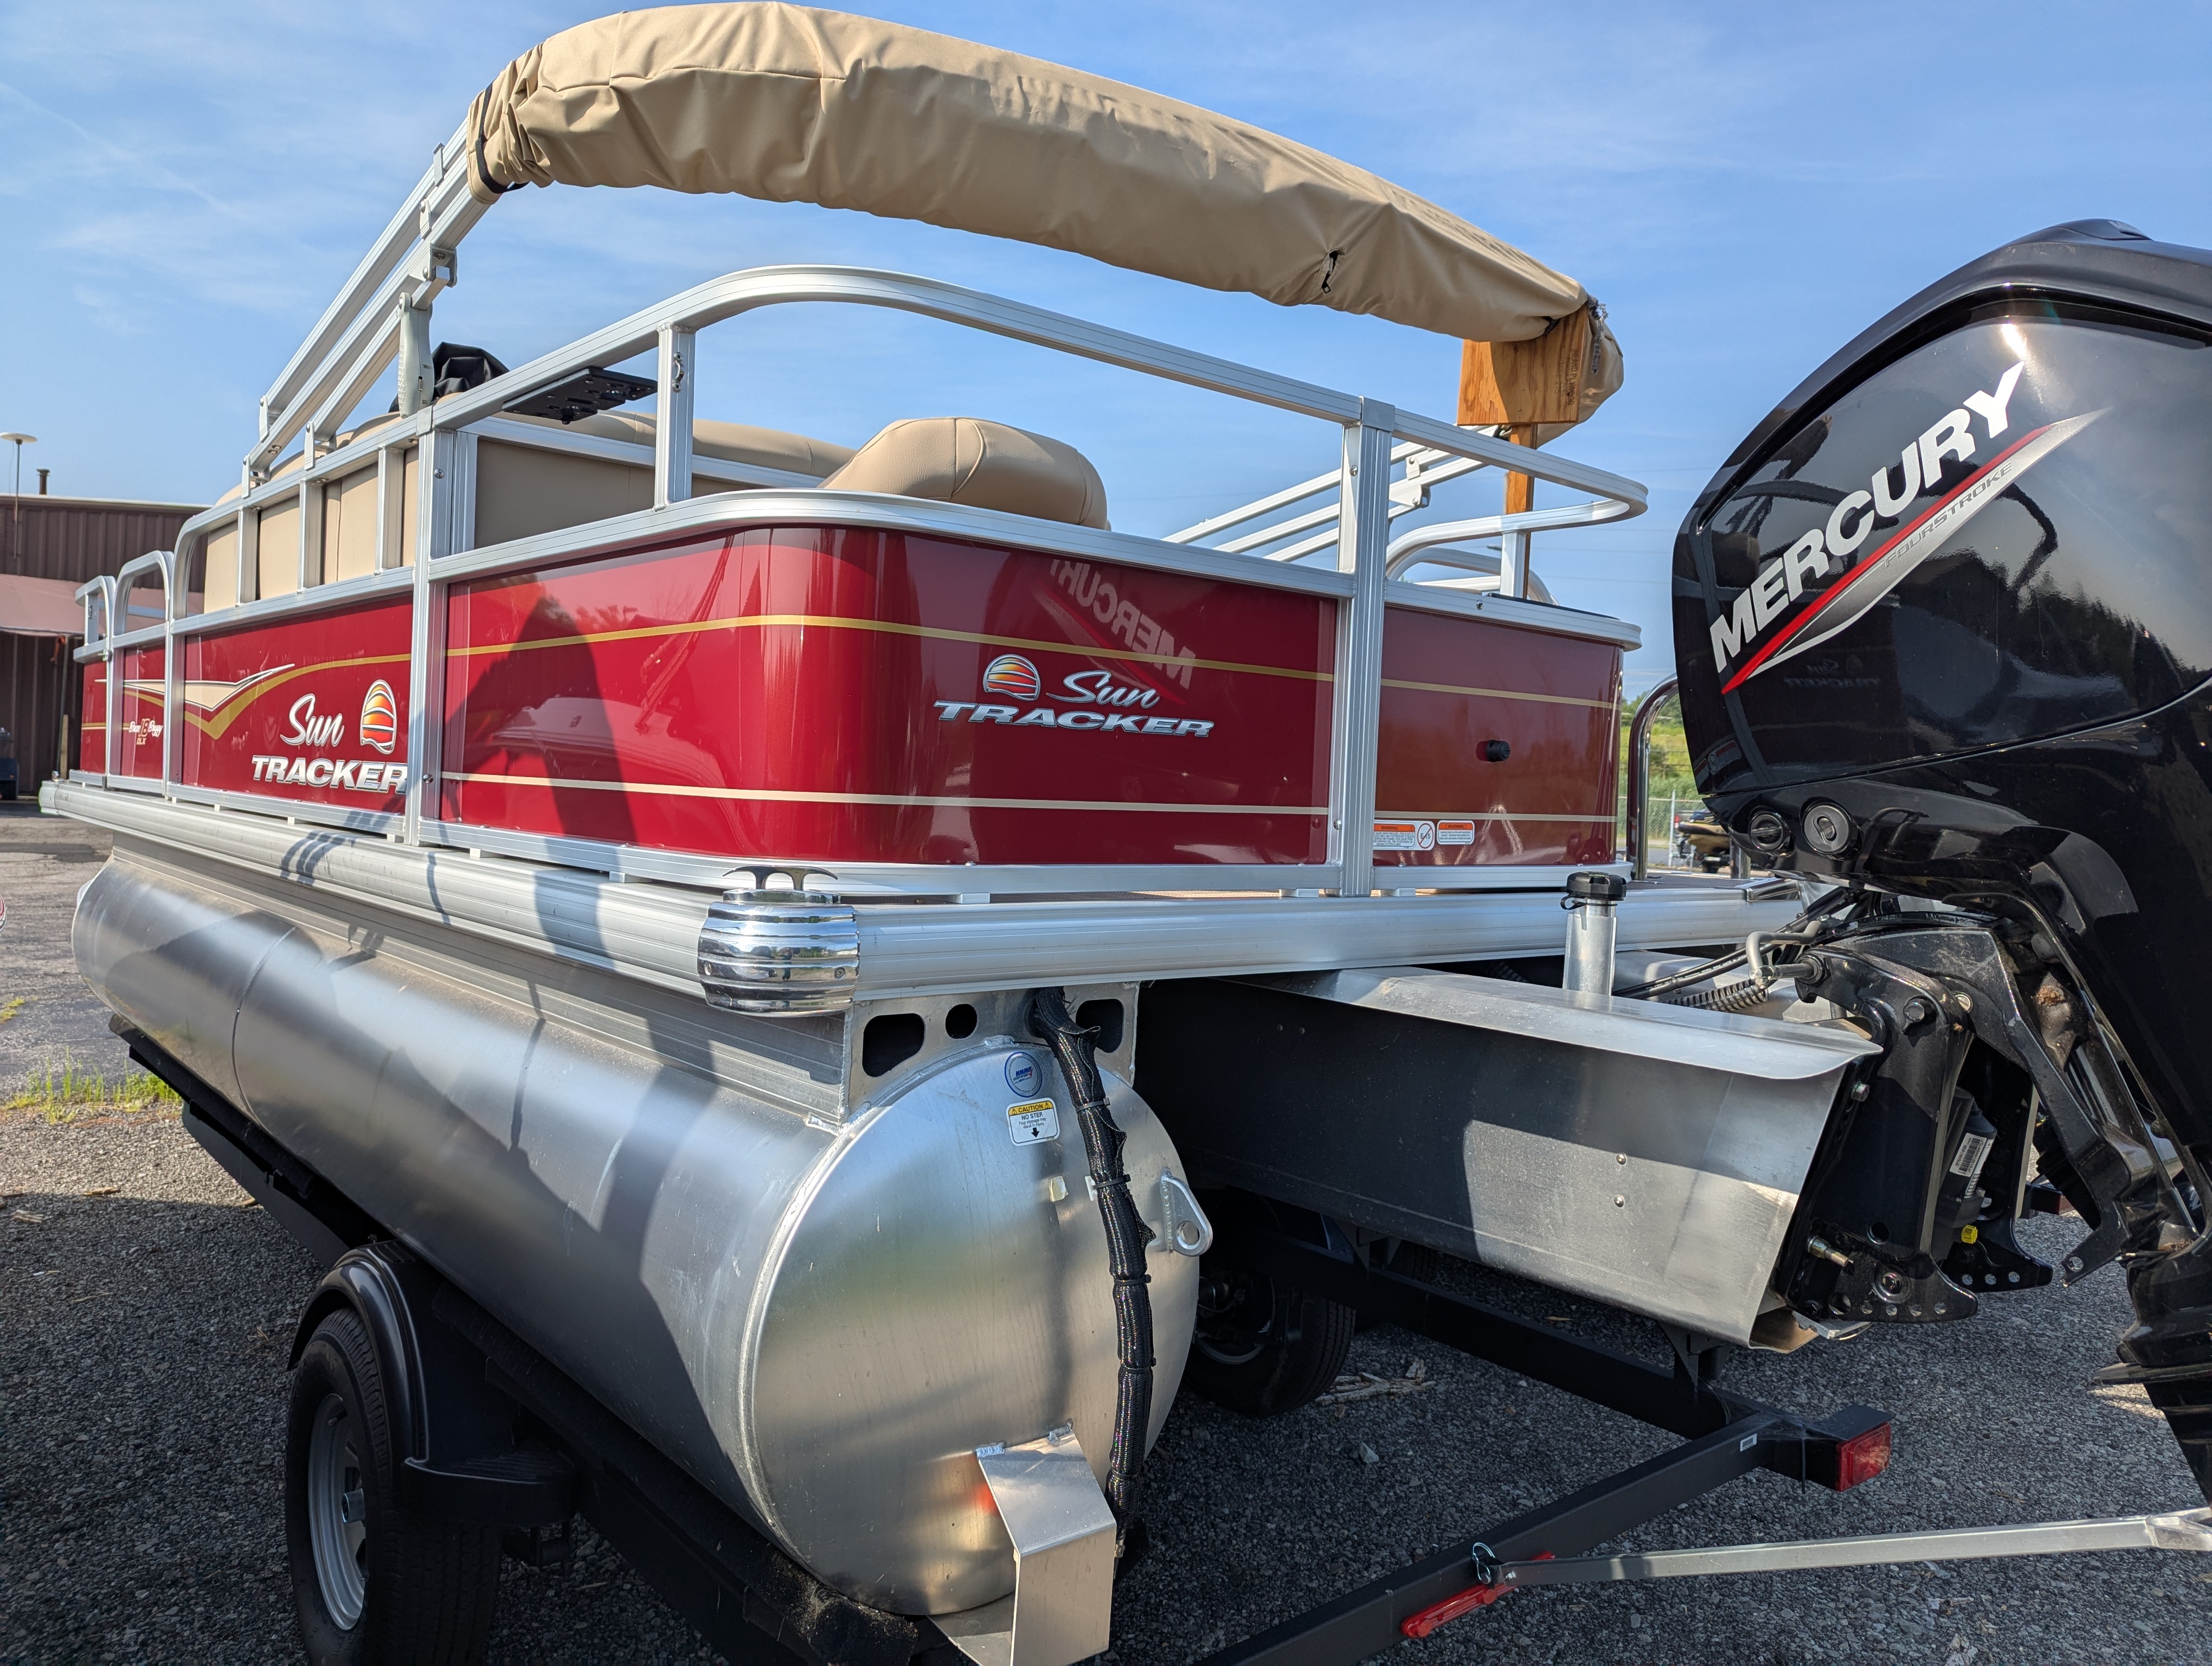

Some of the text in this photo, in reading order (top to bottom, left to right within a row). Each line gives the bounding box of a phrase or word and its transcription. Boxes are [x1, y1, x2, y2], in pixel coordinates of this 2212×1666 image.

[1709, 361, 2024, 674] MERCURY
[1884, 462, 2012, 567] FOURSTROKE
[1046, 670, 1160, 708] Sun
[128, 721, 141, 733] Bass
[138, 718, 151, 737] 18
[280, 693, 345, 747] Sun
[934, 700, 1214, 737] TRACKER
[136, 737, 146, 745] DLX
[252, 754, 408, 794] TRACKER
[1018, 1104, 1044, 1113] CAUTION
